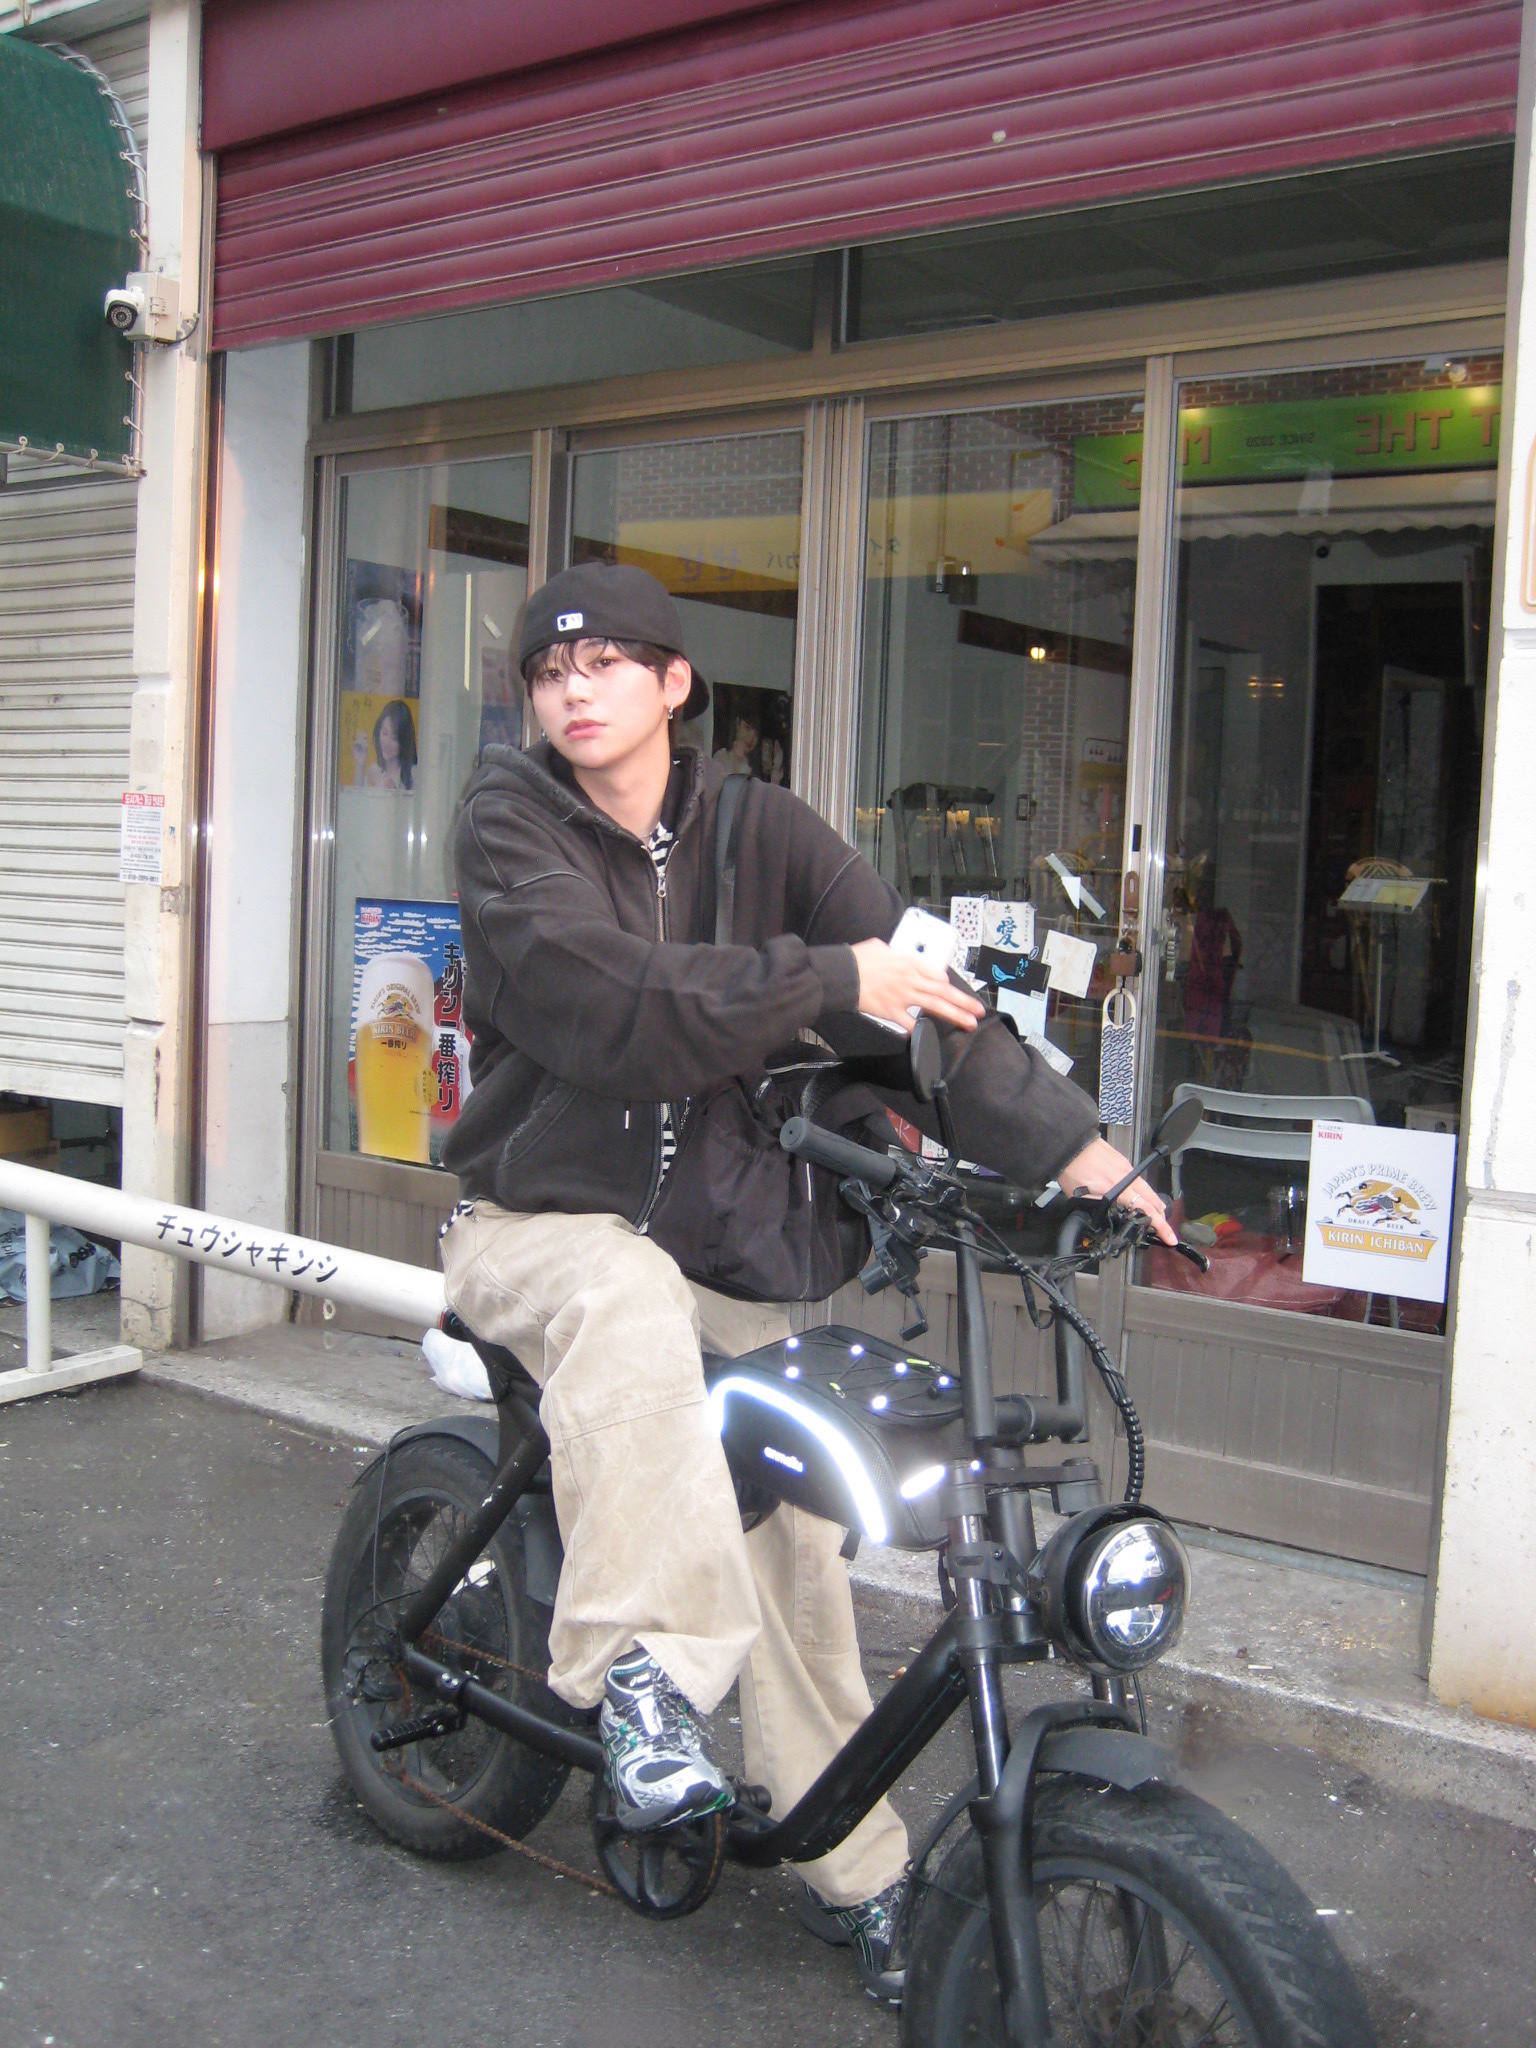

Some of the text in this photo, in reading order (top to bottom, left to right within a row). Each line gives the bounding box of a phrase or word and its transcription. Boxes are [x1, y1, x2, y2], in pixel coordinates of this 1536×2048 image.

[994, 915, 1021, 948] 愛
[437, 941, 460, 1112] キリン一番搾り
[1318, 1131, 1343, 1140] KIRIN
[1322, 1163, 1437, 1211] JAPAN'S PRIME BREW
[1347, 1217, 1370, 1225] DRAFT
[155, 1214, 340, 1284] チュウシャキンシ
[1327, 1230, 1425, 1254] KIRIN ICHIBAN
